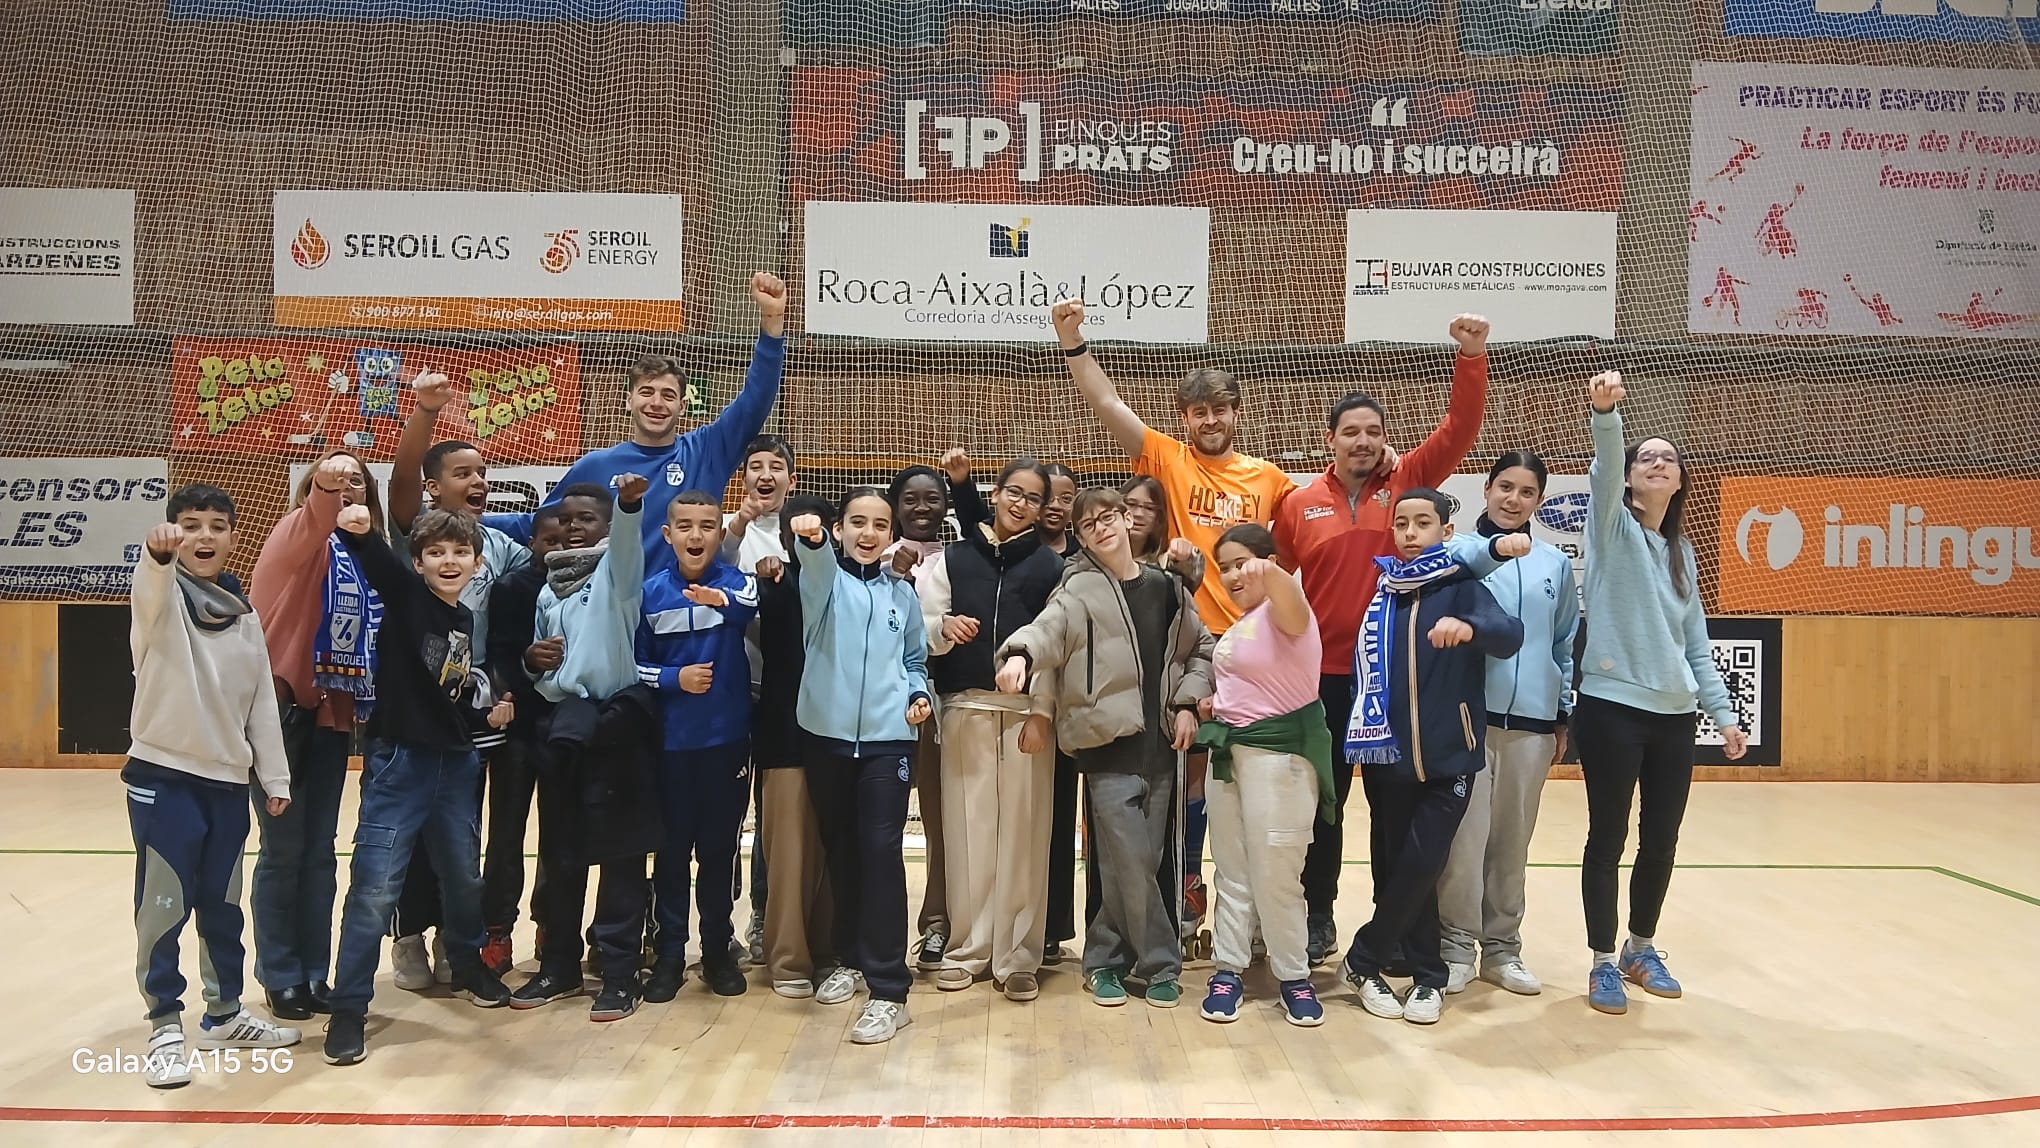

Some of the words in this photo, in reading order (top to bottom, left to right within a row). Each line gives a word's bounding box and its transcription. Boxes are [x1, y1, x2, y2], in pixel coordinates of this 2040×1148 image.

[1739, 85, 1872, 110] PRACTICAR
[1879, 88, 1970, 112] ESPORT
[1977, 86, 2006, 113] ÉS
[1055, 119, 1172, 145] FINQUES
[1801, 126, 1831, 150] La
[1919, 129, 1950, 152] de
[1958, 130, 2040, 159] l'espo
[1055, 145, 1172, 171] PRATS
[1233, 137, 1373, 174] Creu-ho
[1384, 139, 1393, 174] i
[1404, 140, 1560, 176] succeirà
[344, 233, 445, 259] SEROIL
[451, 234, 511, 261] GAS
[588, 230, 651, 247] SEROIL
[0, 250, 120, 270] RDEÑES
[588, 249, 659, 266] ENERGY
[1391, 262, 1453, 277] BUJVAR
[1457, 262, 1606, 277] CONSTRUCCIONES
[1391, 281, 1460, 291] ESTRUCTURAS
[1463, 280, 1515, 291] METÁLICAS
[366, 305, 388, 318] 900
[489, 307, 613, 322] info@seroilgas.com
[905, 308, 986, 325] Corredoria
[991, 311, 1105, 329] d'Asseguces
[198, 354, 284, 399] Peta
[197, 382, 293, 434] Zetas
[468, 387, 558, 438] Zetas
[1188, 484, 1261, 520] HOCKEY
[0, 511, 88, 548] ES
[81, 572, 106, 585] 902
